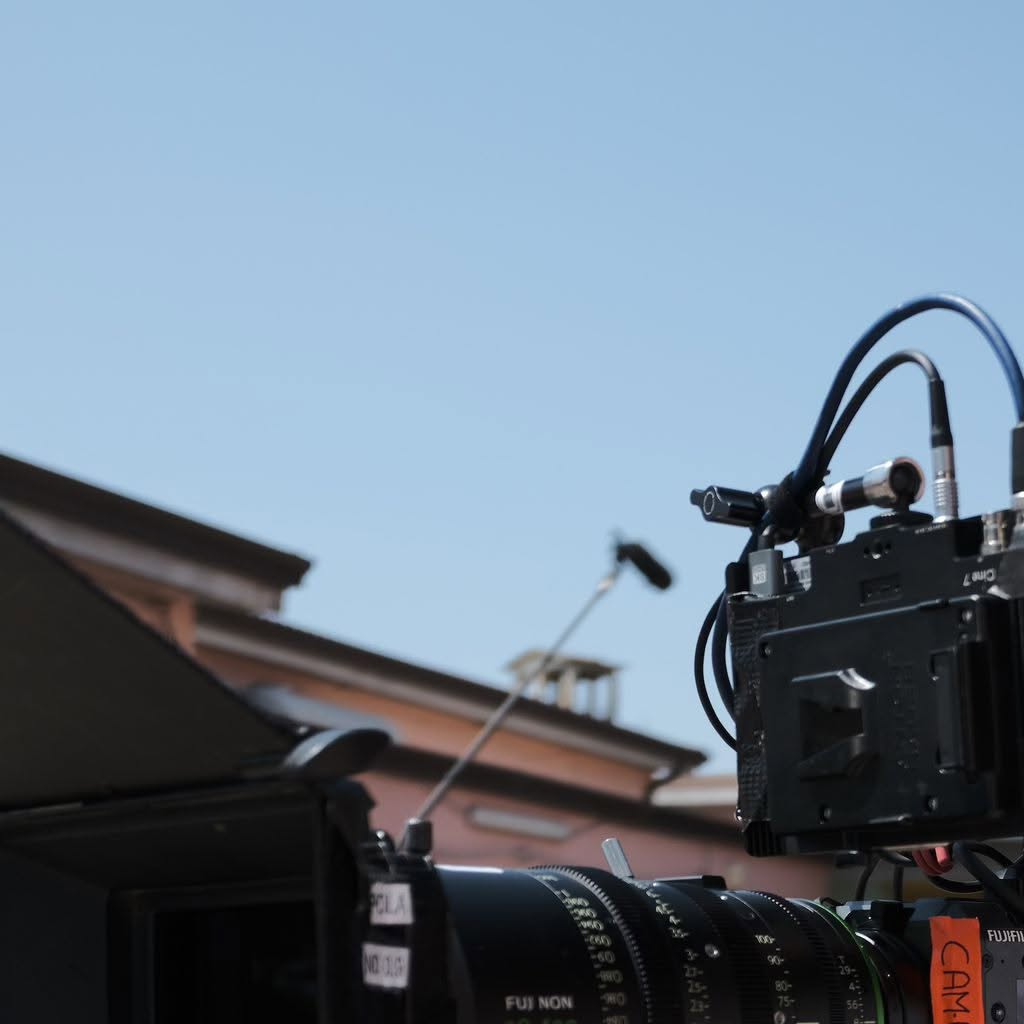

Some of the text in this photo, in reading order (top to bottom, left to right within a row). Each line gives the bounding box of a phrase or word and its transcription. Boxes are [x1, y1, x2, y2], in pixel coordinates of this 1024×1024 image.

[972, 567, 997, 583] Cine
[754, 934, 773, 945] 100
[767, 955, 780, 966] 90
[775, 979, 788, 992] 80
[848, 982, 856, 992] 4
[504, 995, 574, 1011] FUJNON
[777, 996, 790, 1008] 75
